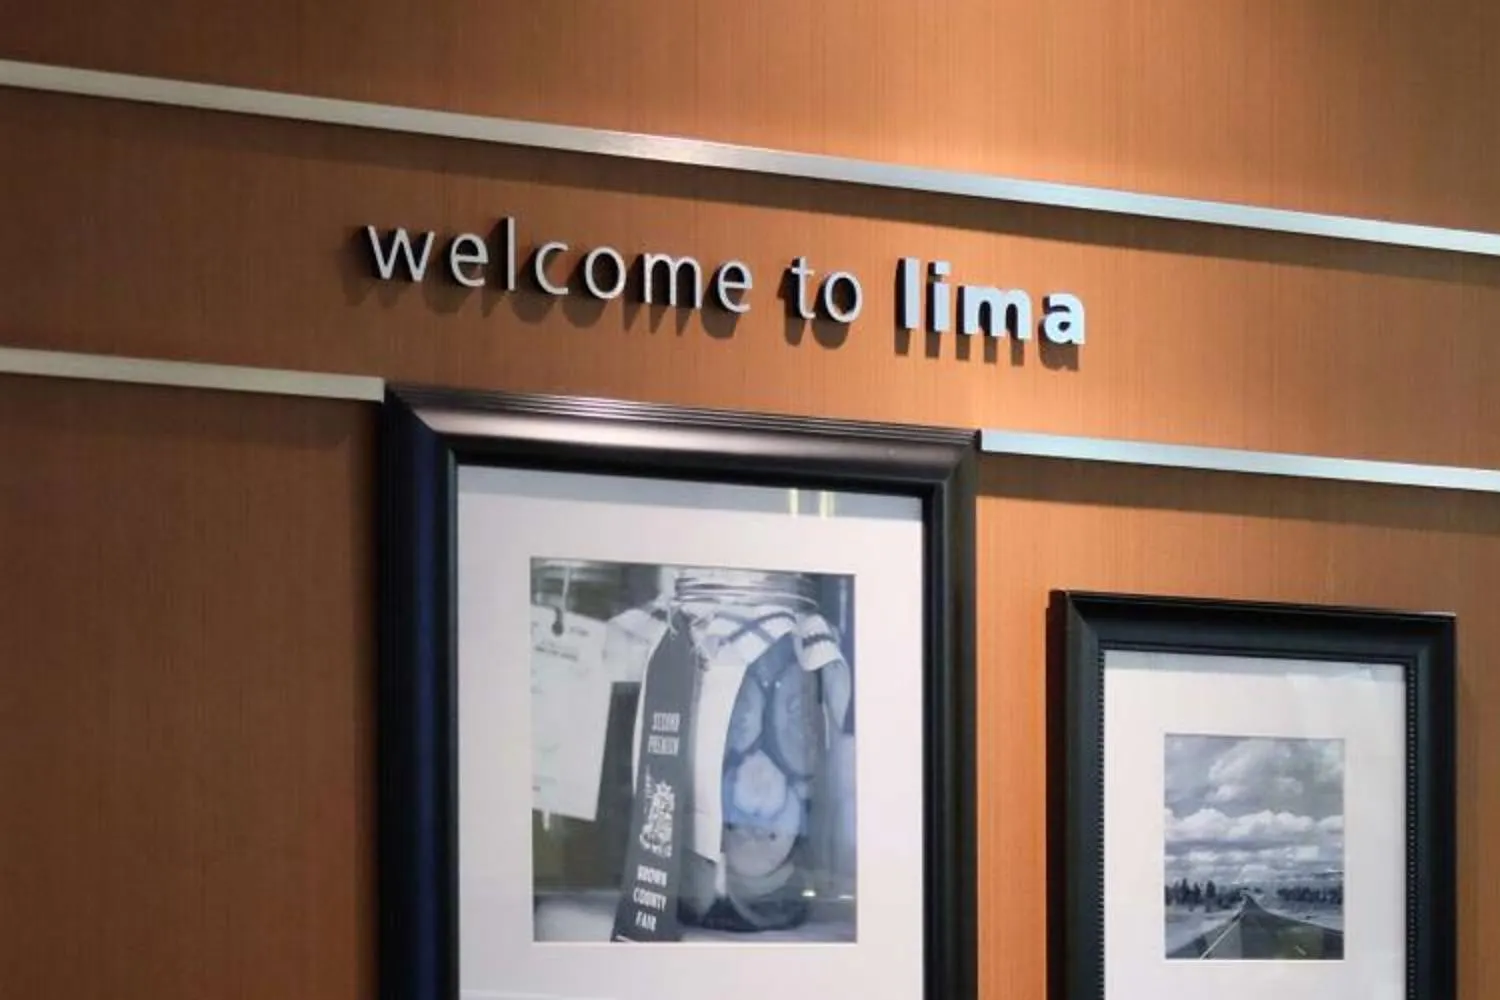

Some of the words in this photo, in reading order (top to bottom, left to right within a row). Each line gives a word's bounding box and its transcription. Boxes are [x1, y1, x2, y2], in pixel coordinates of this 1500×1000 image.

[366, 217, 753, 313] welcome
[791, 255, 863, 324] to
[904, 256, 1086, 346] lima
[633, 887, 667, 912] COUNTY
[635, 910, 657, 931] FAIR
